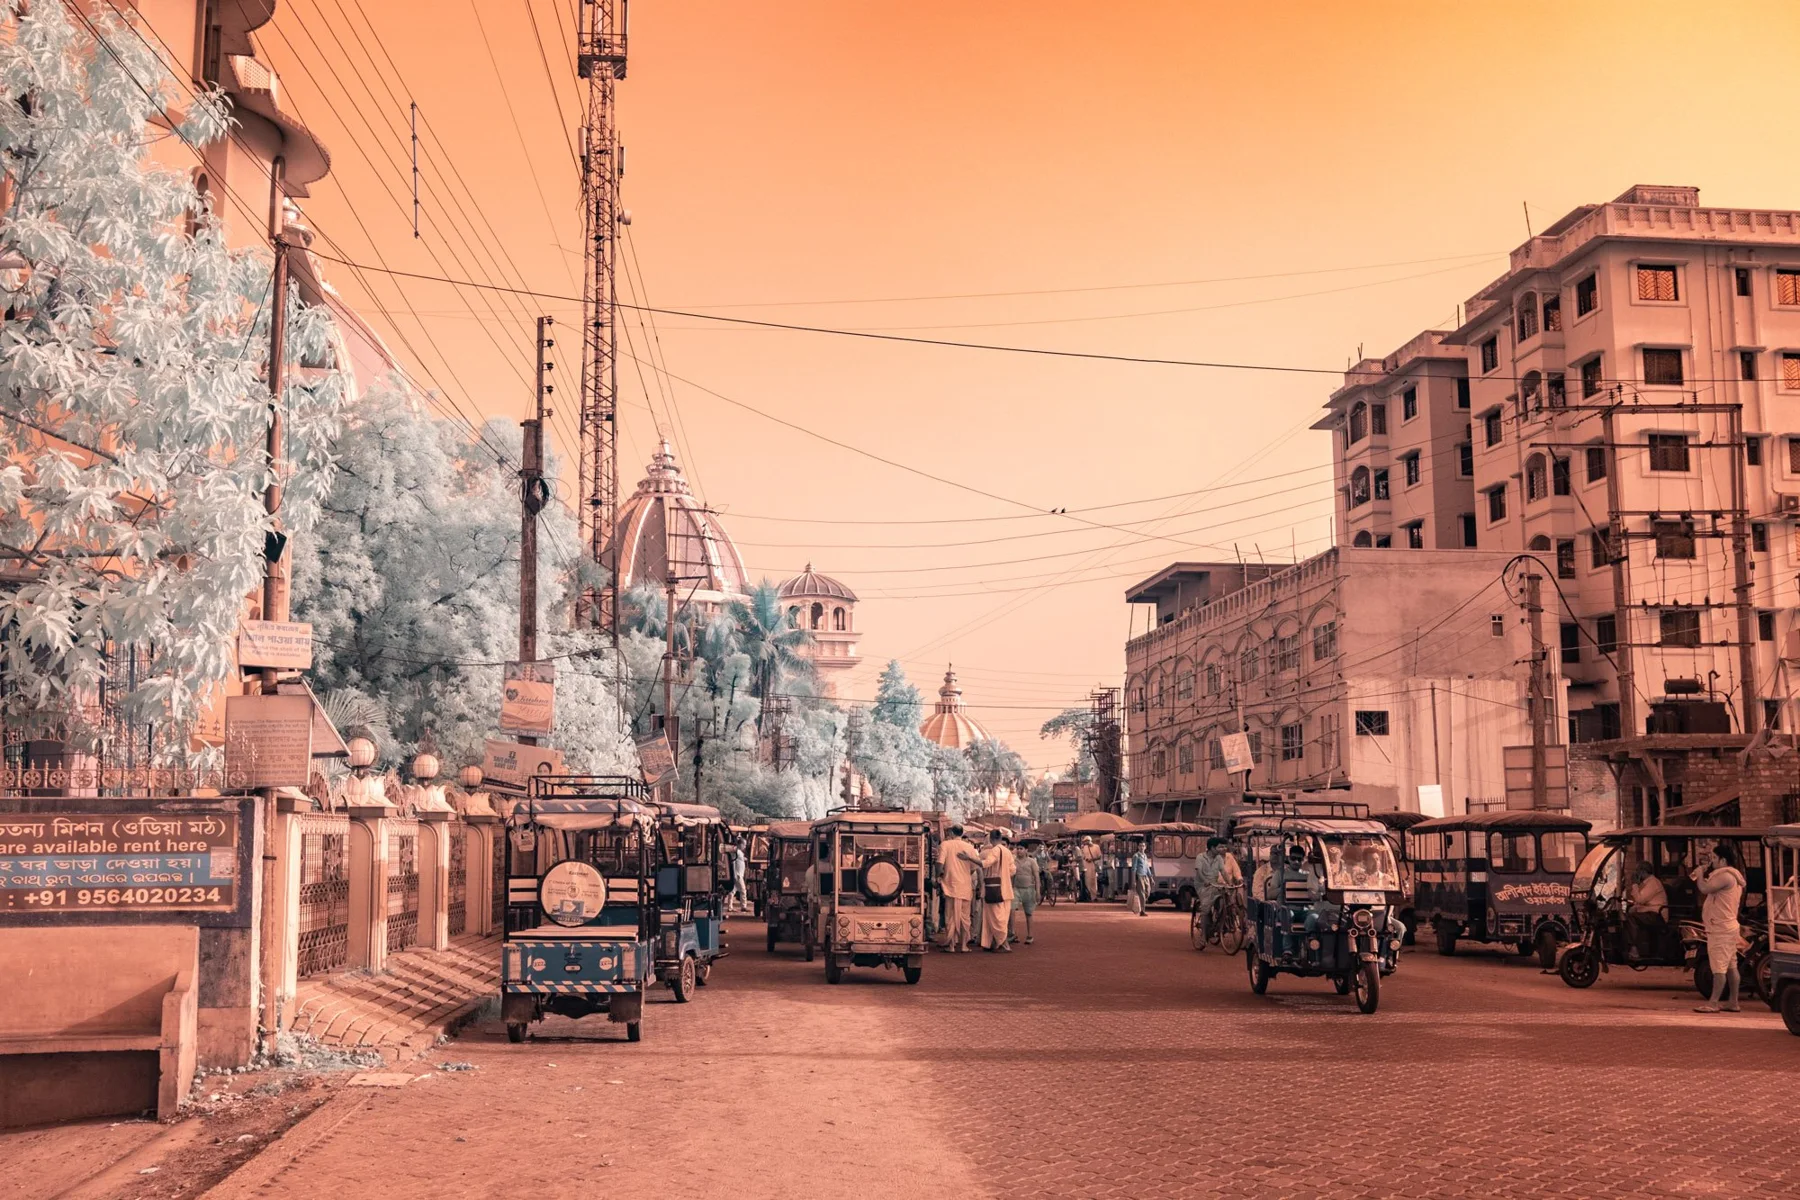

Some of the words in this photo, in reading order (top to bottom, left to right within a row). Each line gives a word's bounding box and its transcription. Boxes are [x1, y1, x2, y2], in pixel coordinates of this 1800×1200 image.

[51, 817, 104, 837] মিশন
[187, 815, 226, 837] মঠ)
[33, 840, 117, 854] available
[124, 840, 161, 852] rent
[167, 839, 207, 852] here
[18, 860, 47, 871] ঘর
[53, 858, 98, 872] ভাড়া
[106, 858, 160, 870] দেওয়া
[24, 889, 67, 906] +91
[77, 887, 220, 904] 9564020234
[1531, 882, 1571, 897] ইঞ্জিনিয়া
